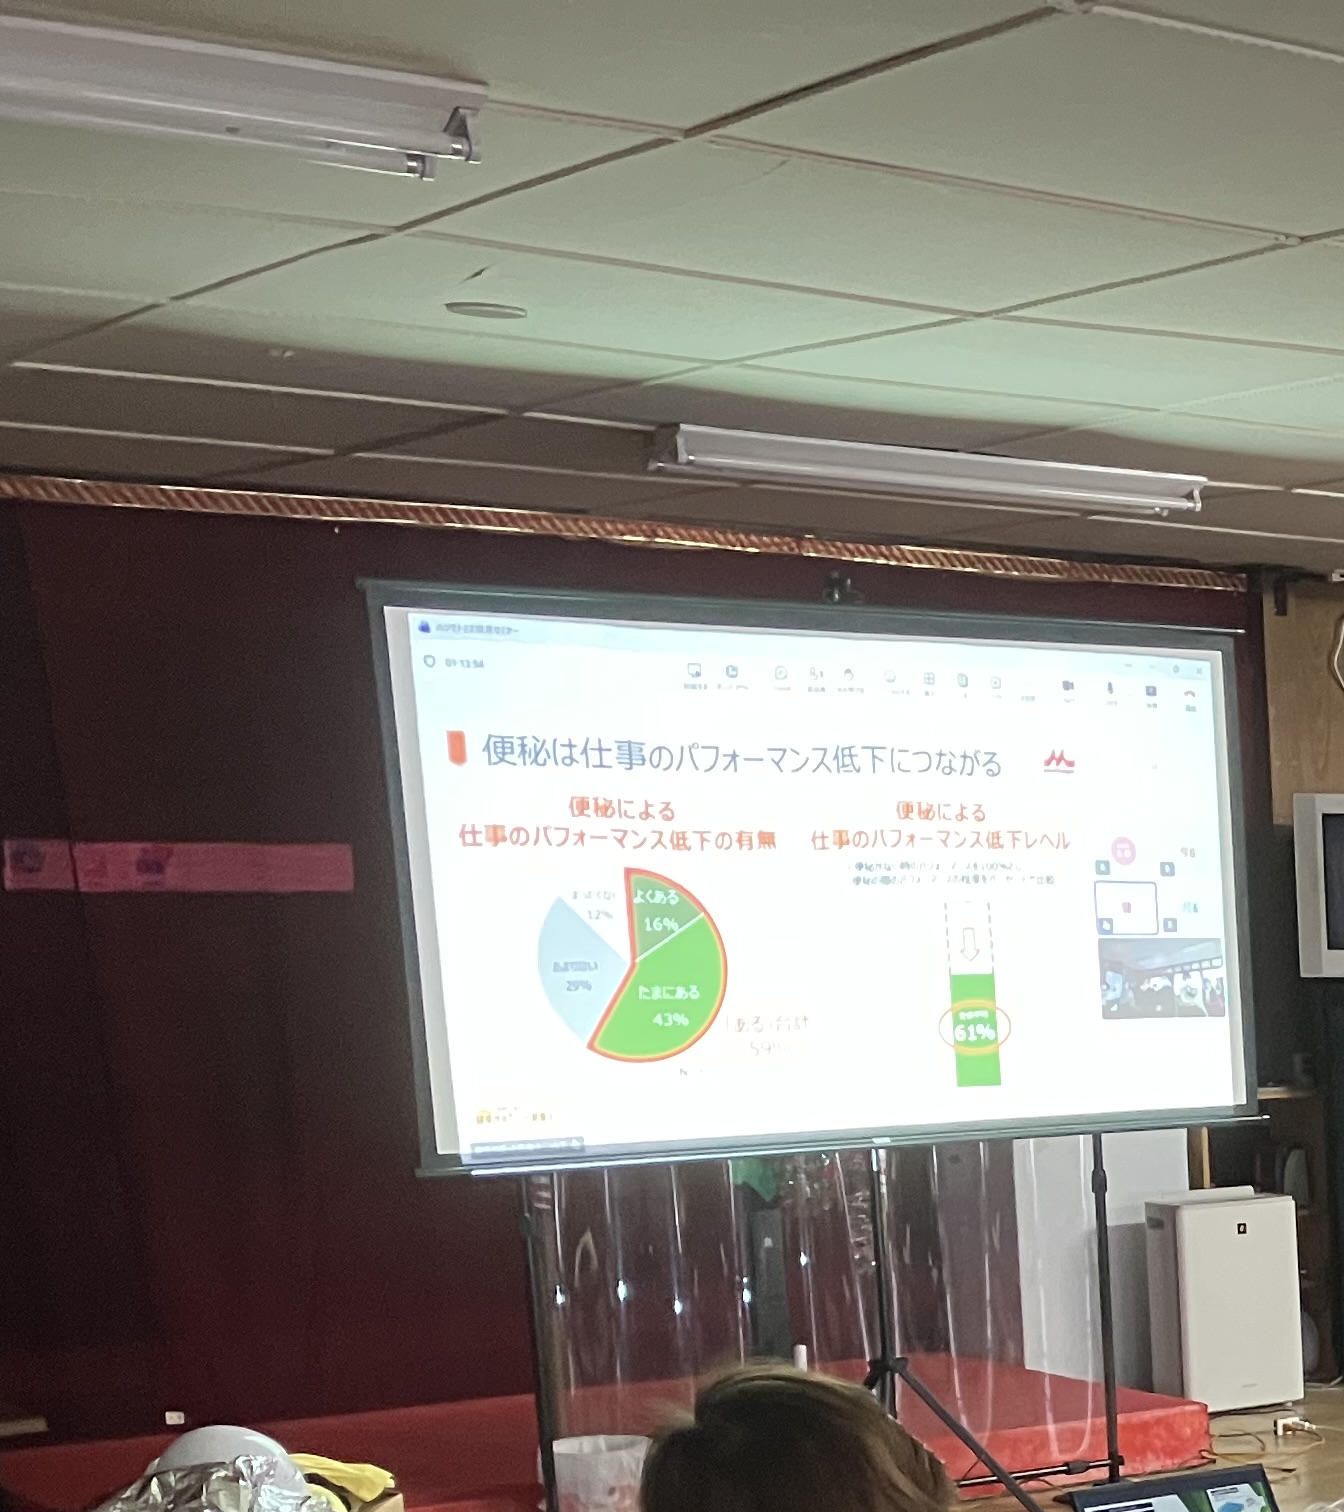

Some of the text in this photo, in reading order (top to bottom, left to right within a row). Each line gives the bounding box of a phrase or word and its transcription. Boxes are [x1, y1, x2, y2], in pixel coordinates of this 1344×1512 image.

[482, 733, 1001, 777] 便秘は仕事のパフォーマンス低下につながる
[569, 796, 675, 821] 便秘による
[897, 801, 986, 822] 便秘による
[459, 824, 777, 851] 仕事のパフォーマンス低下の有無
[633, 889, 679, 905] よくある
[645, 917, 679, 932] 16%
[638, 984, 701, 1001] たまにある
[653, 1012, 689, 1027] 43%
[955, 1023, 996, 1041] 61%
